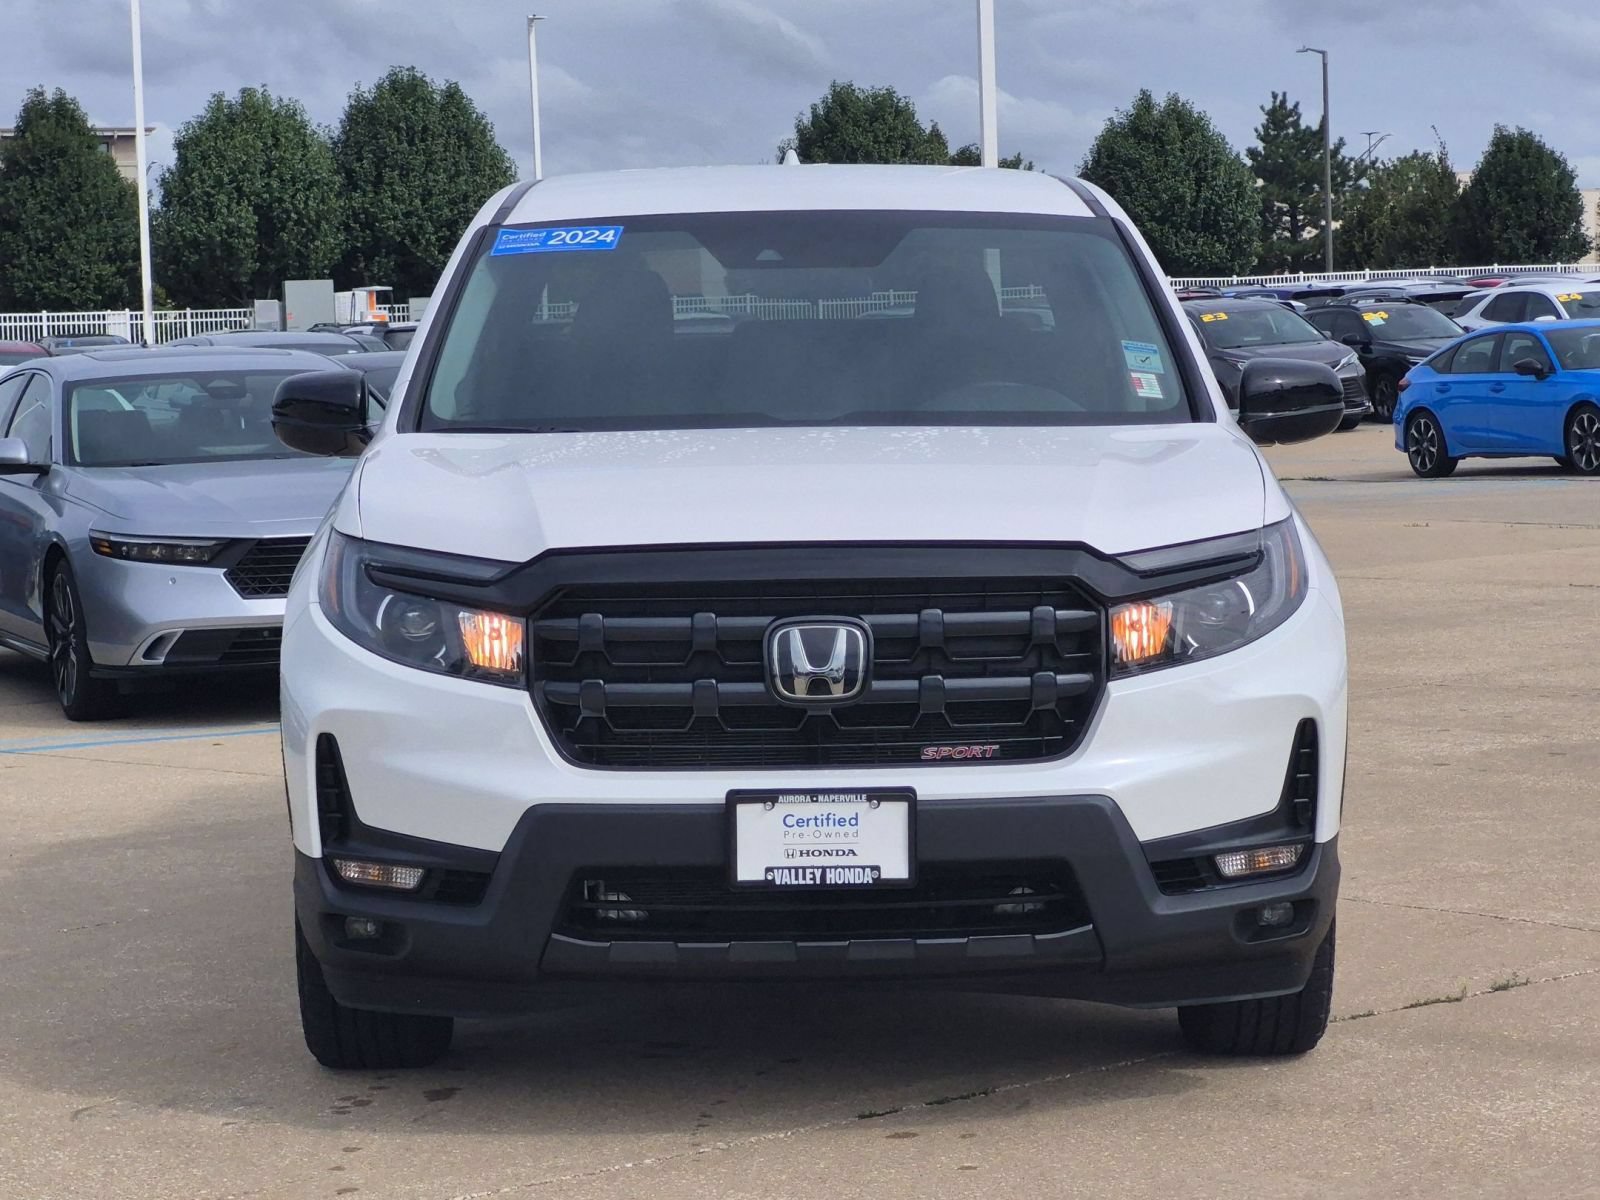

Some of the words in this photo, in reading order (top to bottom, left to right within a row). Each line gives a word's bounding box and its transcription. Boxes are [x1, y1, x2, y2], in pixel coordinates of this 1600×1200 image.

[547, 229, 616, 245] 2024
[1200, 312, 1229, 323] 23
[921, 745, 1000, 760] SPORT
[778, 795, 811, 803] AURORA
[818, 794, 867, 802] NAPERVILLE
[783, 812, 859, 828] Certified
[783, 830, 859, 839] Pre-Owned
[799, 849, 858, 857] HONDA
[774, 868, 822, 884] VALLEY
[826, 868, 873, 884] HONDA
